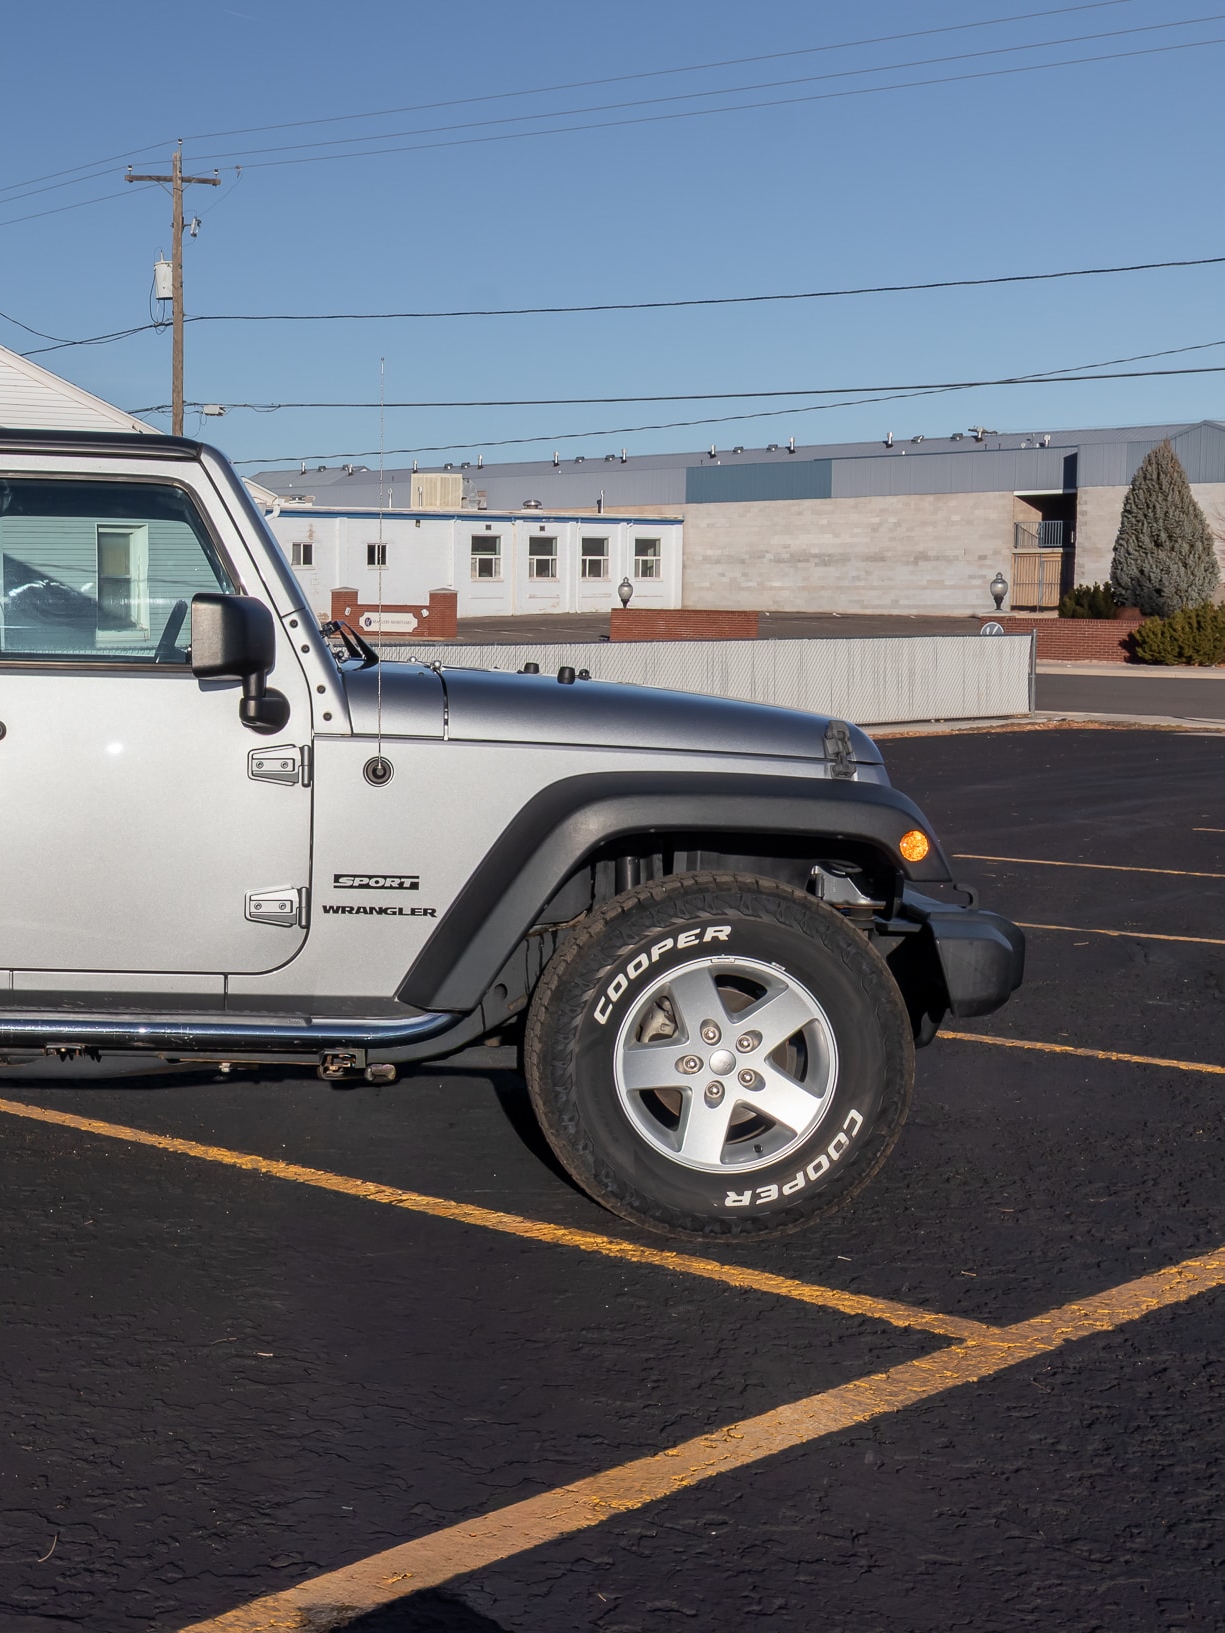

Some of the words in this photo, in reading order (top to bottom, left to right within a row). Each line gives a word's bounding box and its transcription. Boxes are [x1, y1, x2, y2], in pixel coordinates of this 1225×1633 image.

[334, 875, 419, 888] SPORT
[322, 905, 437, 918] WRANGLER
[593, 925, 732, 1025] COOPER
[724, 1108, 864, 1207] COOPER
